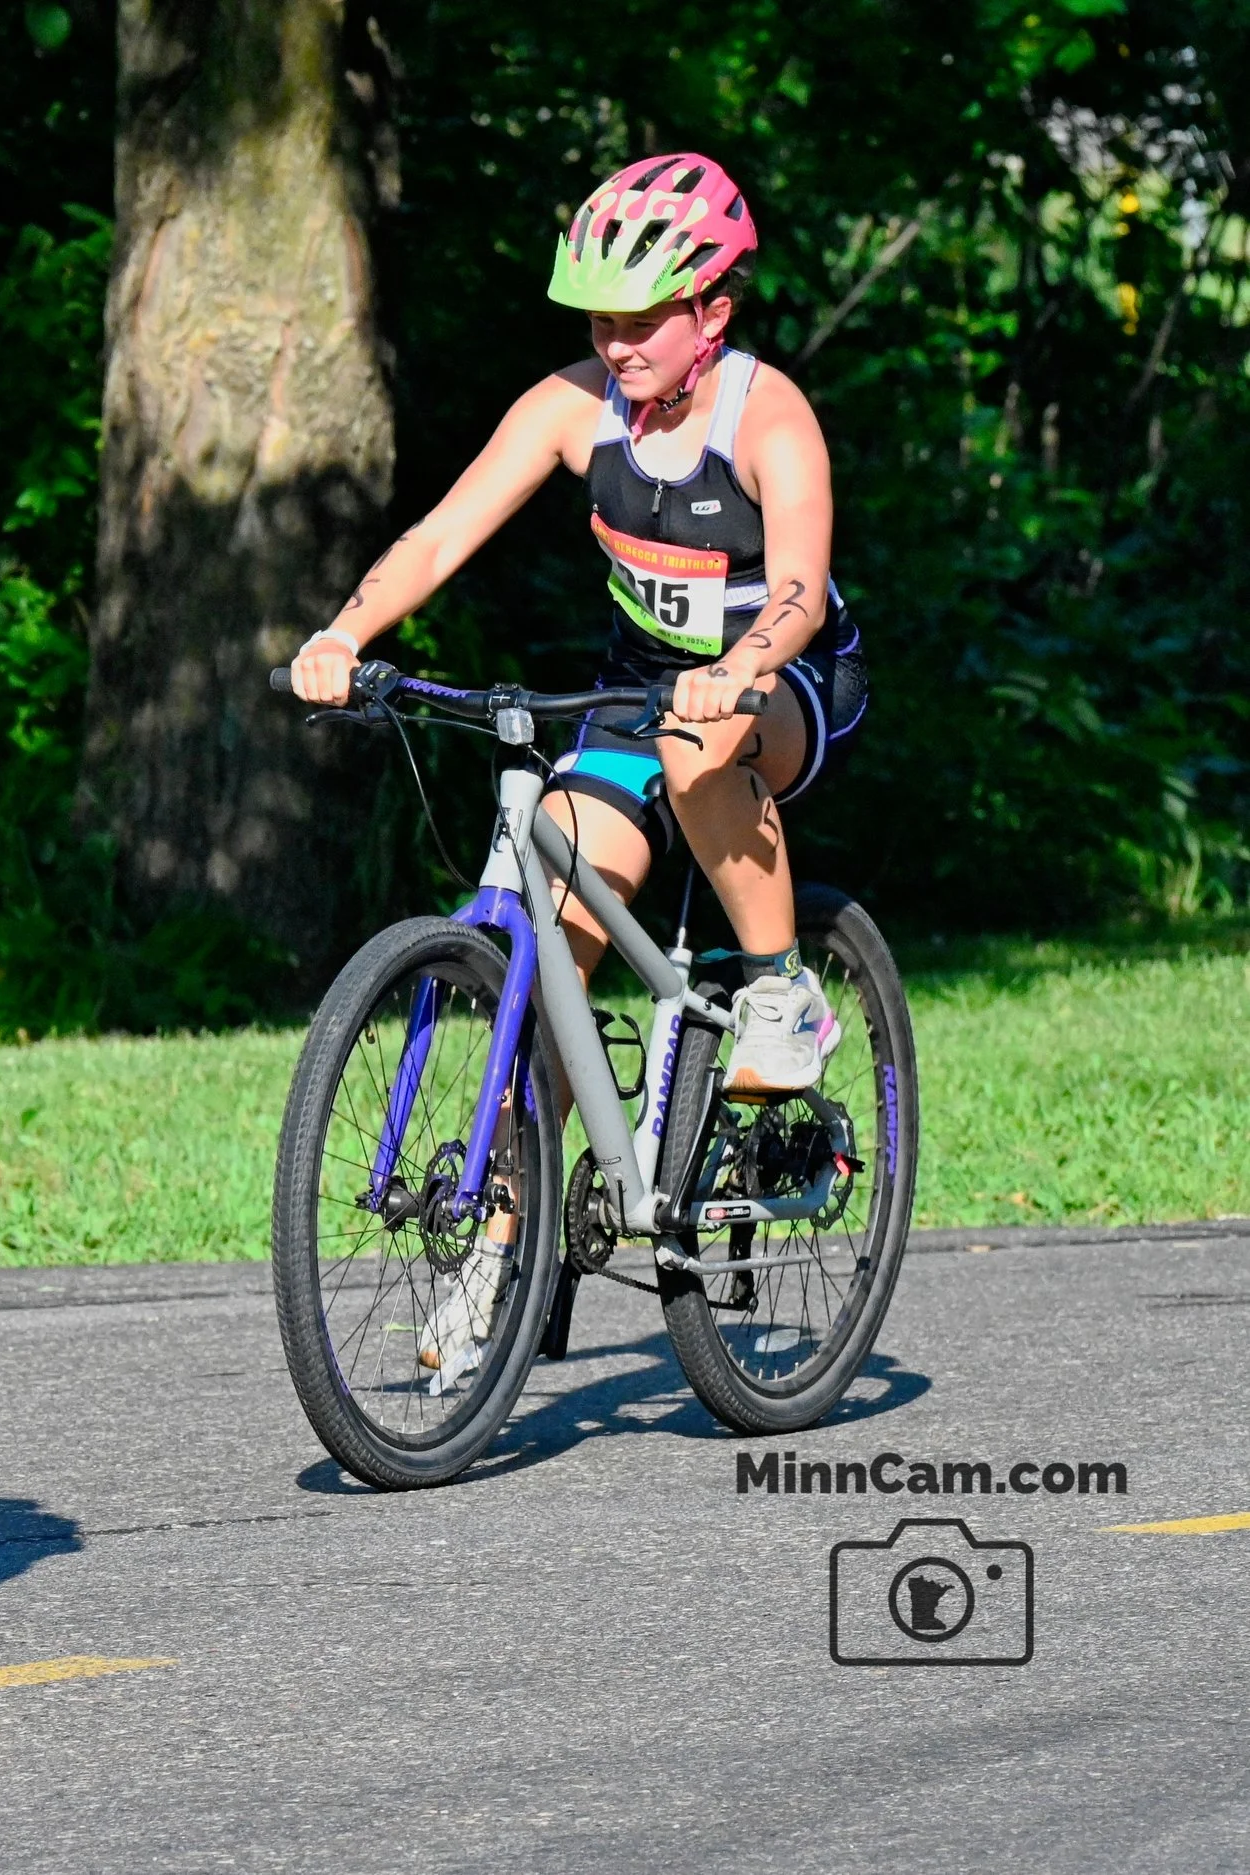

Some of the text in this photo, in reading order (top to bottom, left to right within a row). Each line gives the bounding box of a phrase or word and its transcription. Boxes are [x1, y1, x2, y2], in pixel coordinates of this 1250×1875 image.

[651, 254, 677, 291] SPECIALIZED
[661, 554, 722, 571] TRIATHLON
[747, 579, 809, 650] 215
